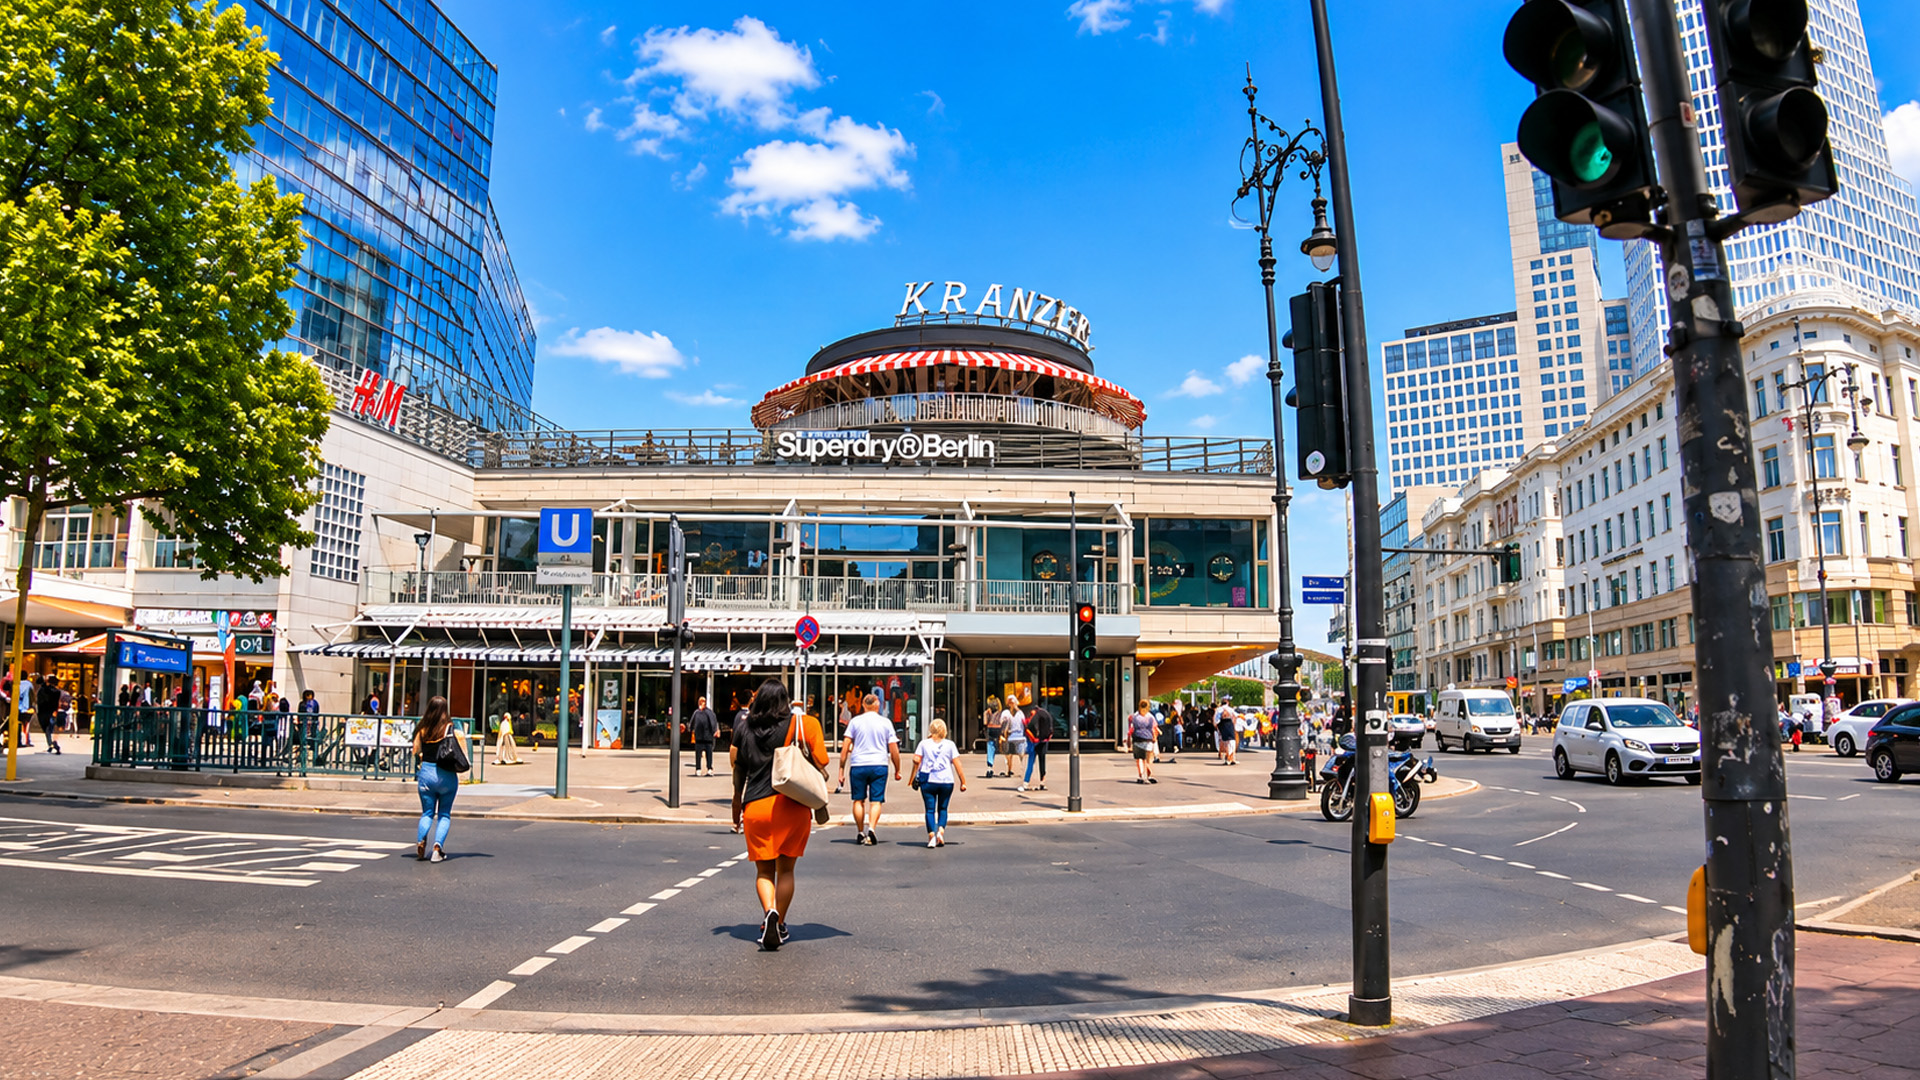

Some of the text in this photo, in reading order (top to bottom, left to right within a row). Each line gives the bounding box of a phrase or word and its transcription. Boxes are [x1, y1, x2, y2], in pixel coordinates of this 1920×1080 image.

[897, 281, 1092, 350] KRANZLER
[351, 370, 407, 427] H&M
[550, 513, 580, 548] U
